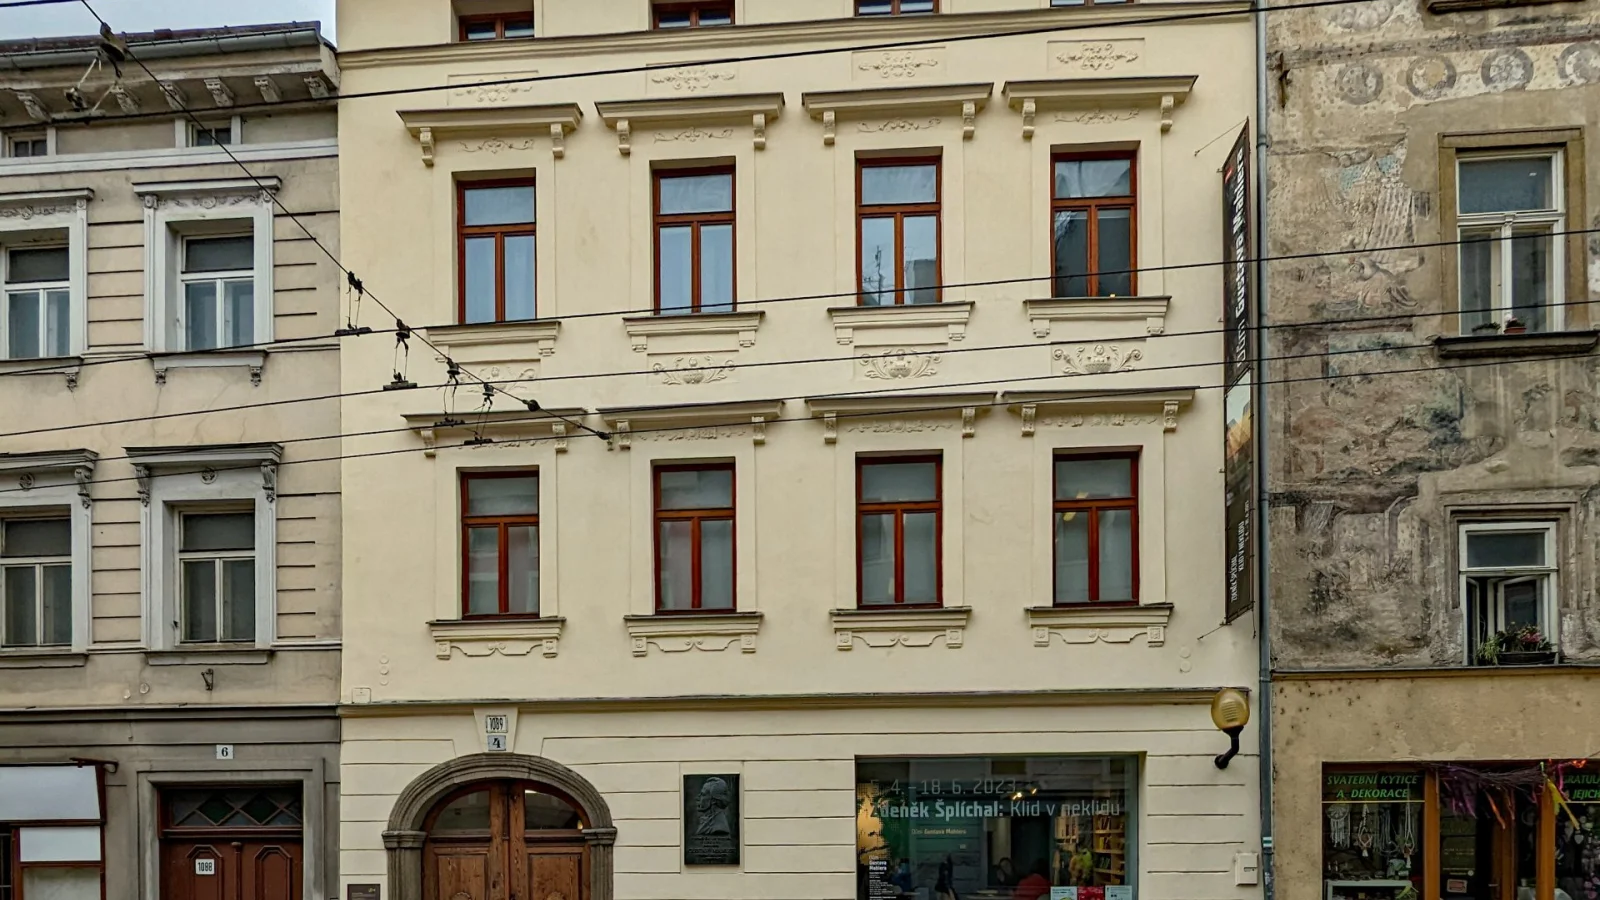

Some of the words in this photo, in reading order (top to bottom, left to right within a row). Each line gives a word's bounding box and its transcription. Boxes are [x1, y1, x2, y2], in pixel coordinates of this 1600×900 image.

[1232, 147, 1245, 234] Mahlera
[1234, 234, 1246, 318] Gustava
[489, 717, 503, 730] 1089
[492, 737, 500, 748] 4
[221, 746, 228, 757] 6
[1327, 773, 1378, 785] SVATEBNÍ
[1380, 775, 1418, 785] KYTICE
[952, 778, 966, 794] 6.
[973, 778, 1016, 794] 2023
[1336, 789, 1344, 798] A
[1351, 788, 1408, 798] DEKORACE
[935, 799, 1003, 821] Šplíchal:
[1010, 799, 1040, 817] Klid
[1046, 804, 1055, 816] v
[1061, 799, 1120, 816] neklidu
[197, 861, 212, 872] 1088
